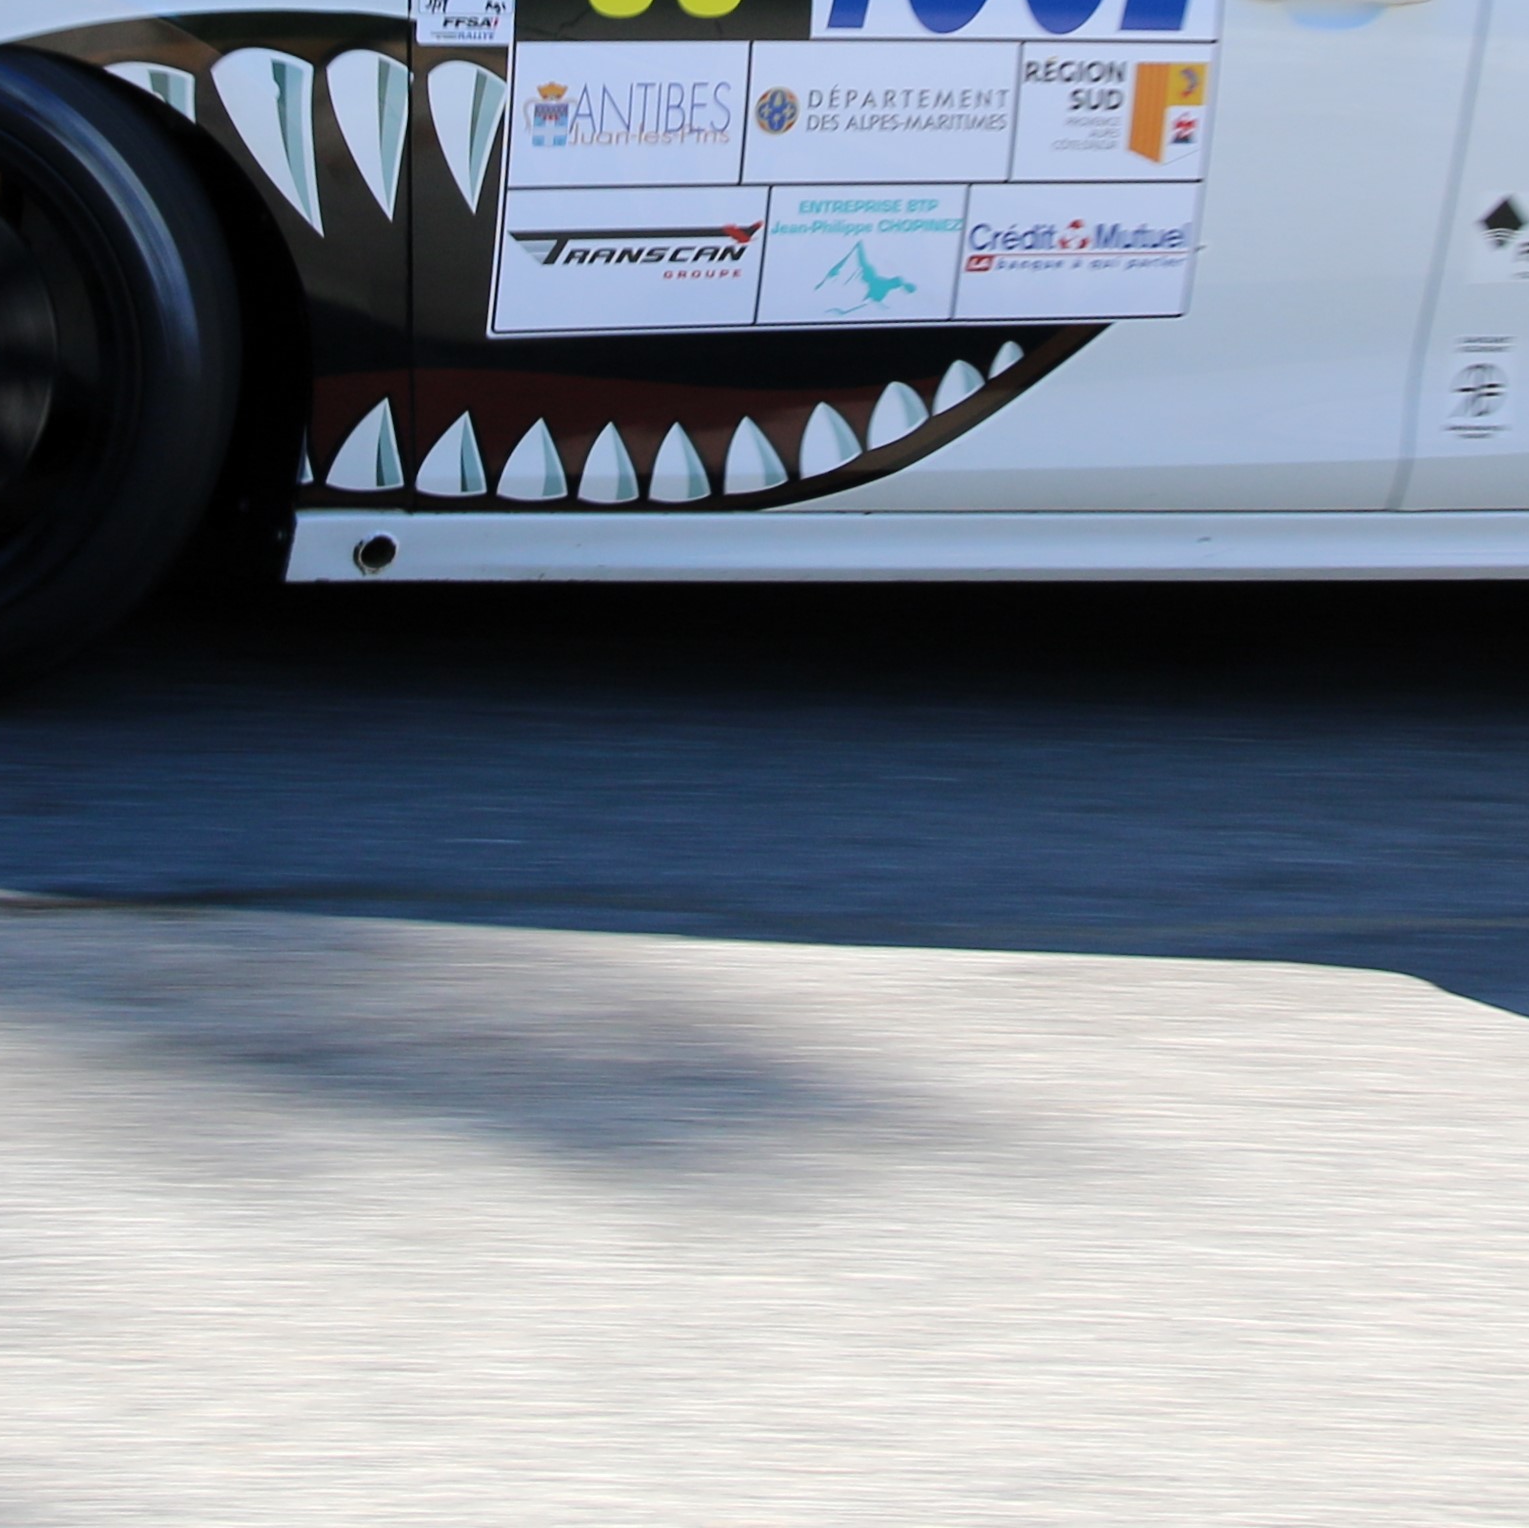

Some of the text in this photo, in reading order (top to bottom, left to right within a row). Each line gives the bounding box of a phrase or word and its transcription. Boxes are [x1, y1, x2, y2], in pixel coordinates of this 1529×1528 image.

[1024, 56, 1127, 82] RÉGION
[570, 82, 732, 134] ANTIBES
[807, 84, 1011, 109] DÉPARTEMENT
[1069, 89, 1125, 110] SUD
[805, 114, 839, 132] DES
[798, 199, 903, 215] ENTREPRISE
[969, 222, 1192, 250] Crédit Mutuel
[663, 269, 743, 279] GROUPE
